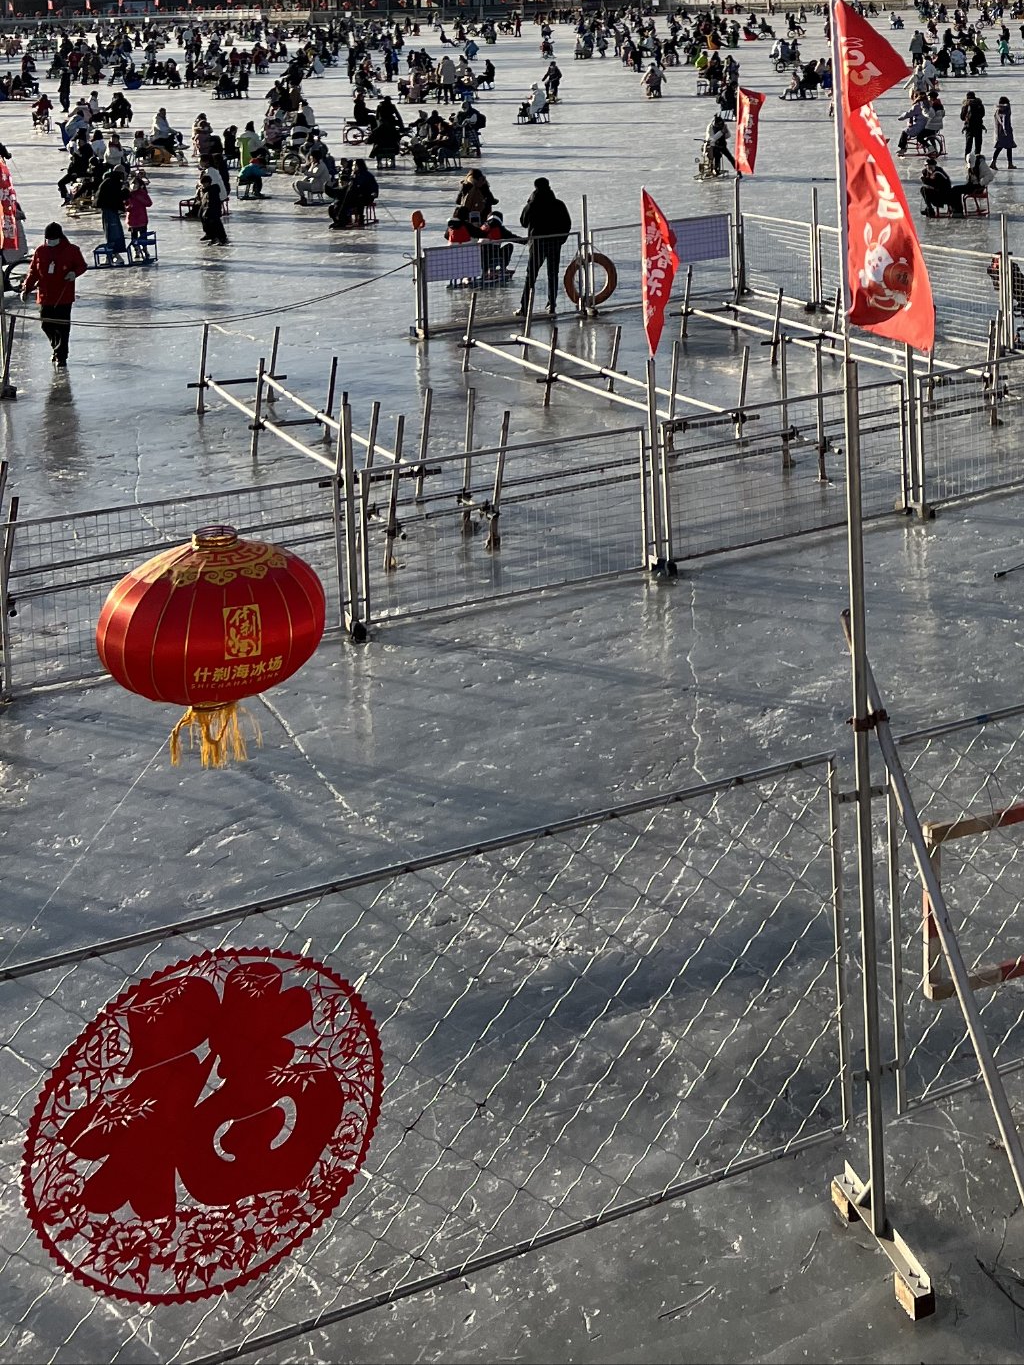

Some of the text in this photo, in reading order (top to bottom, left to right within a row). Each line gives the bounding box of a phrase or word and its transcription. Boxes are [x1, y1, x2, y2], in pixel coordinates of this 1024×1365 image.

[193, 655, 282, 682] 什刹海冰场
[58, 961, 345, 1222] 福
